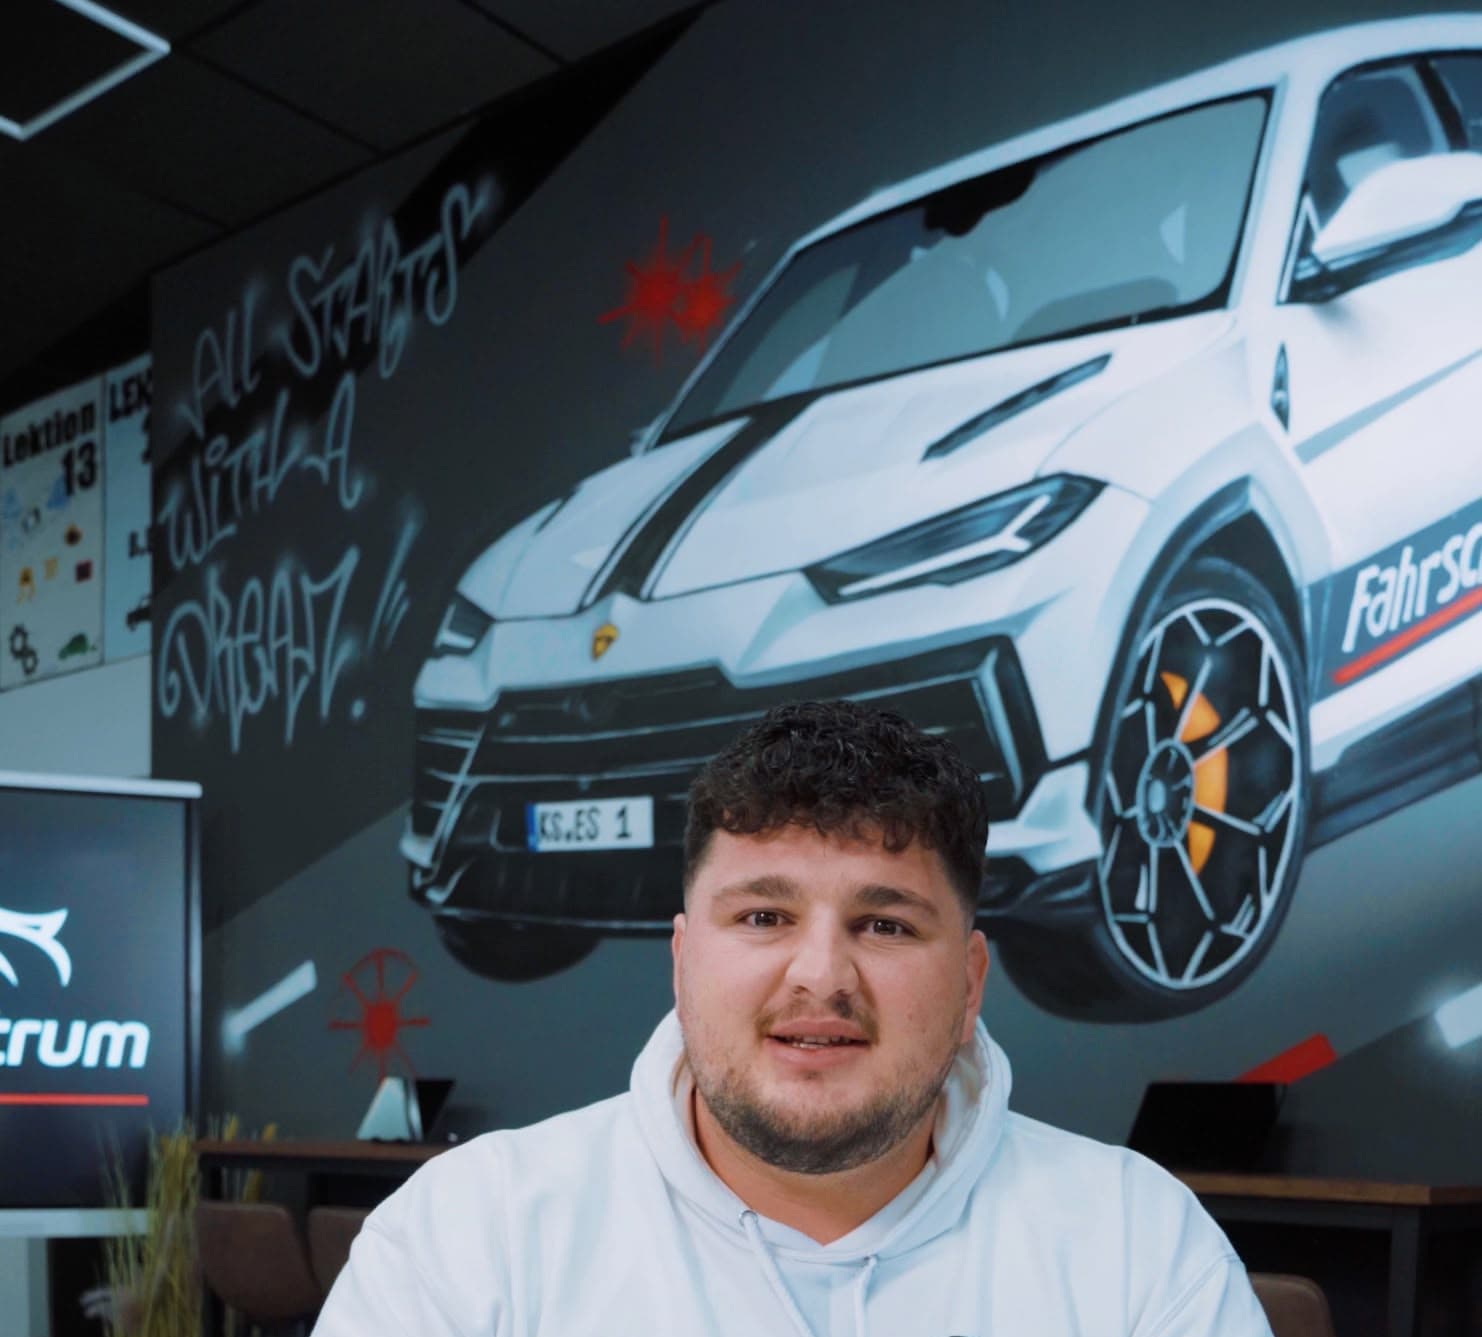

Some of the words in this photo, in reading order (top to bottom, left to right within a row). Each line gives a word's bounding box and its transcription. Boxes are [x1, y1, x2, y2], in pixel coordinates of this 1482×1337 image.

[3, 402, 96, 468] Lektion
[302, 371, 366, 510] A
[62, 441, 97, 496] 13
[616, 806, 632, 839] 1
